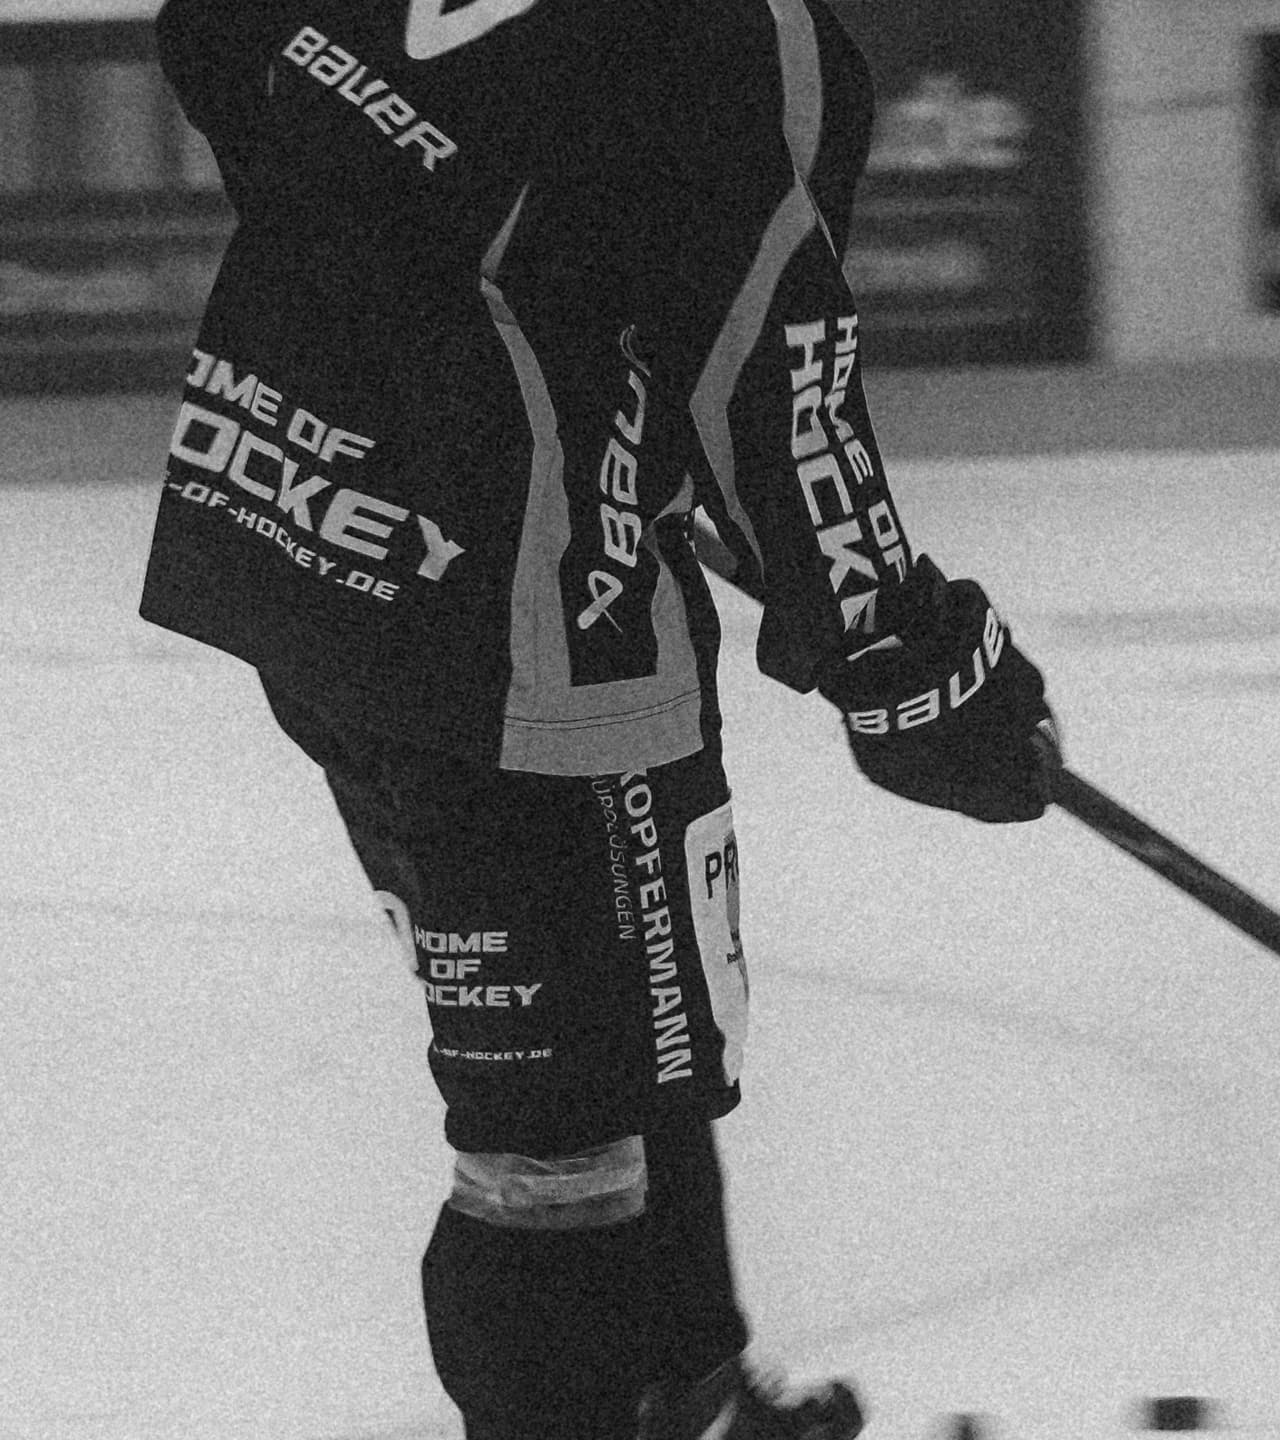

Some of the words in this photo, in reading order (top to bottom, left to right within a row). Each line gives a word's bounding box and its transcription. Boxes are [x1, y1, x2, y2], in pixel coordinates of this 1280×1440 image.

[281, 26, 459, 173] BAUER
[185, 348, 284, 427] OME
[286, 408, 377, 463] OF
[824, 314, 874, 485] HOME
[867, 500, 908, 584] OF
[169, 401, 467, 582] OCKEY
[414, 923, 509, 954] HOME
[424, 982, 543, 1008] OCKEY
[430, 958, 482, 980] OF
